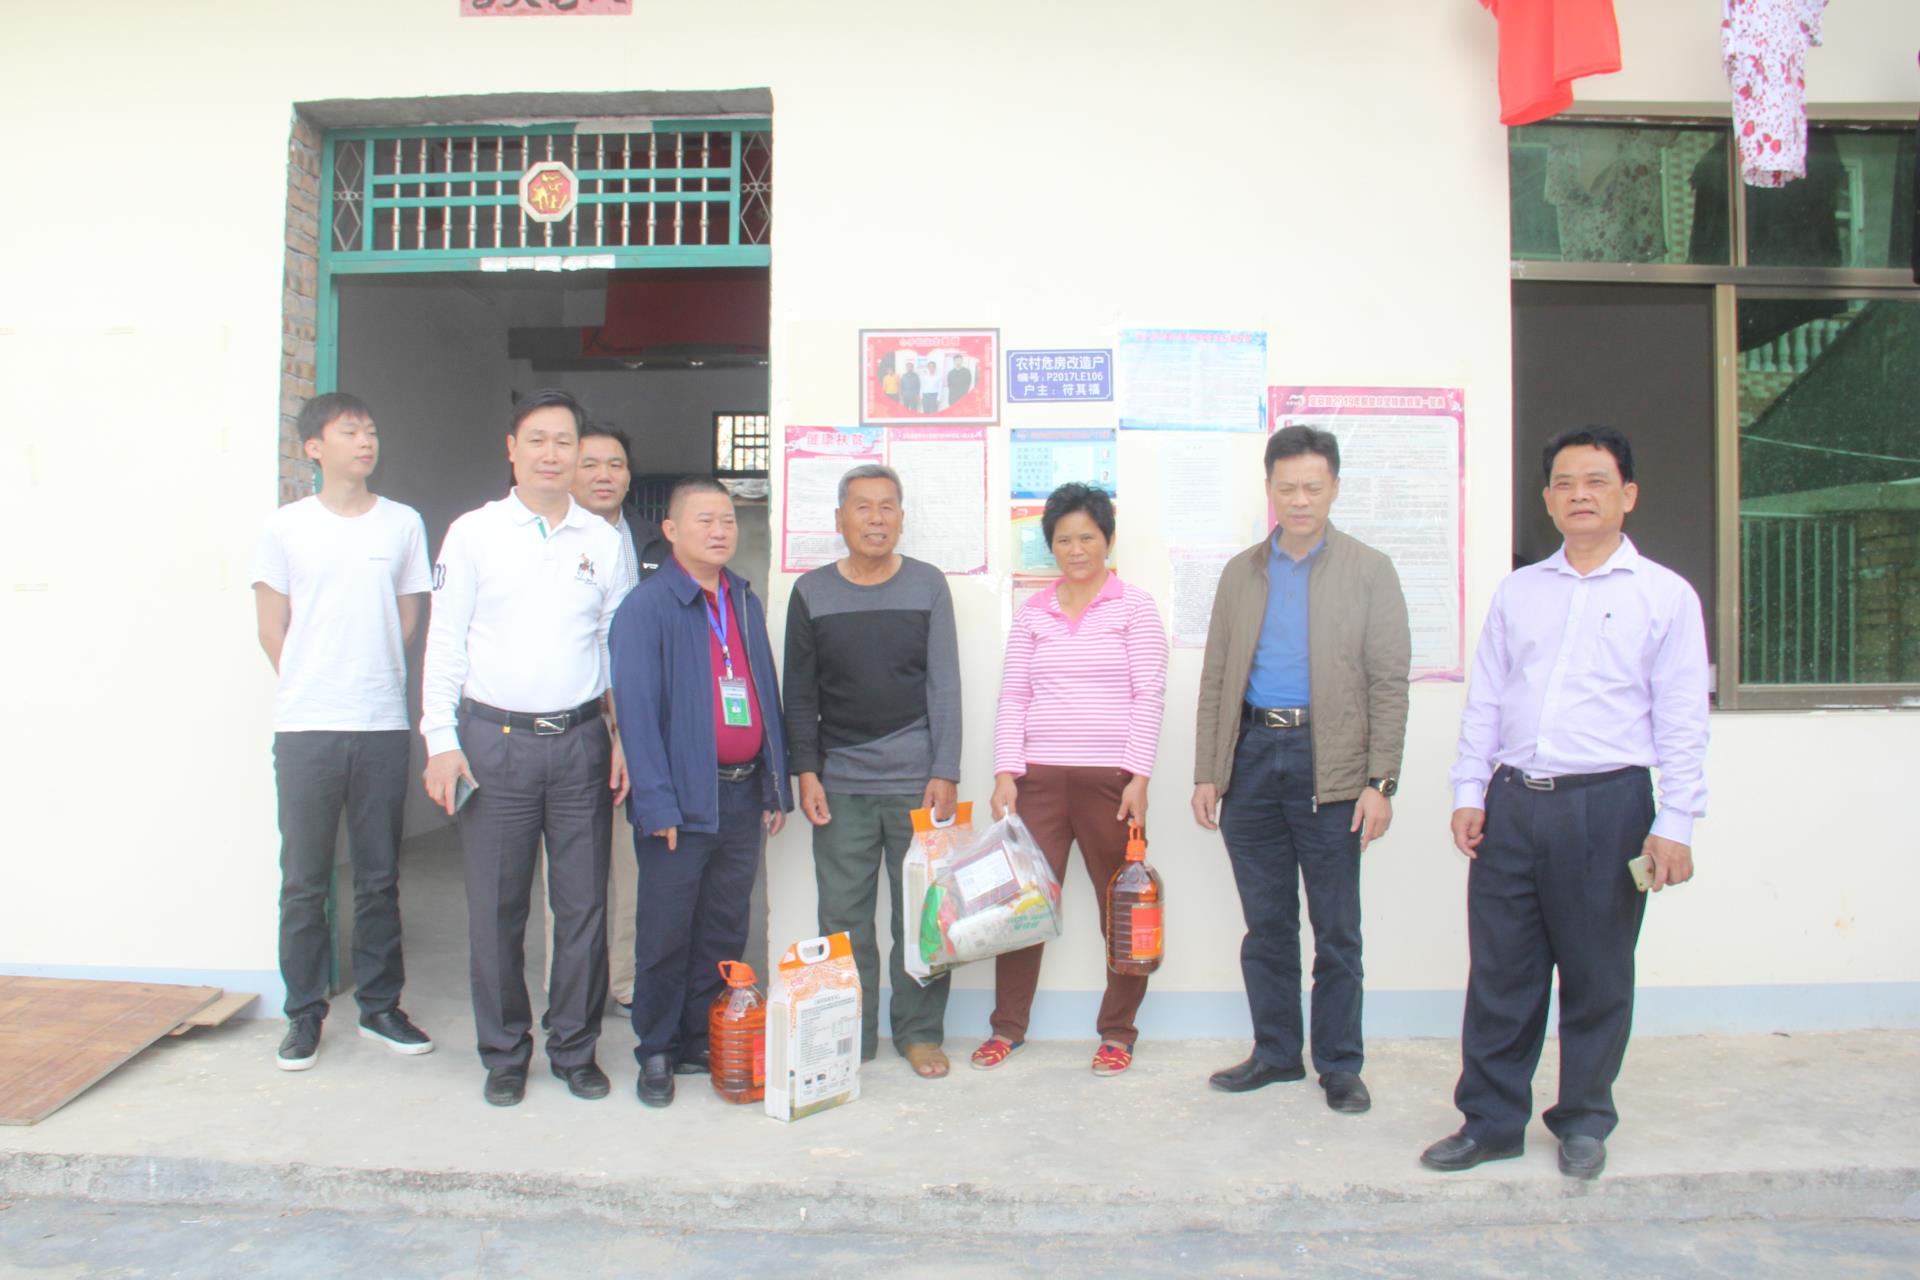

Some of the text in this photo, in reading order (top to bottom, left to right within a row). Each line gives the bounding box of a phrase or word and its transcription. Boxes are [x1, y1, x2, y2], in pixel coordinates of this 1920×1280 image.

[1016, 356, 1104, 371] 农村危房改造户
